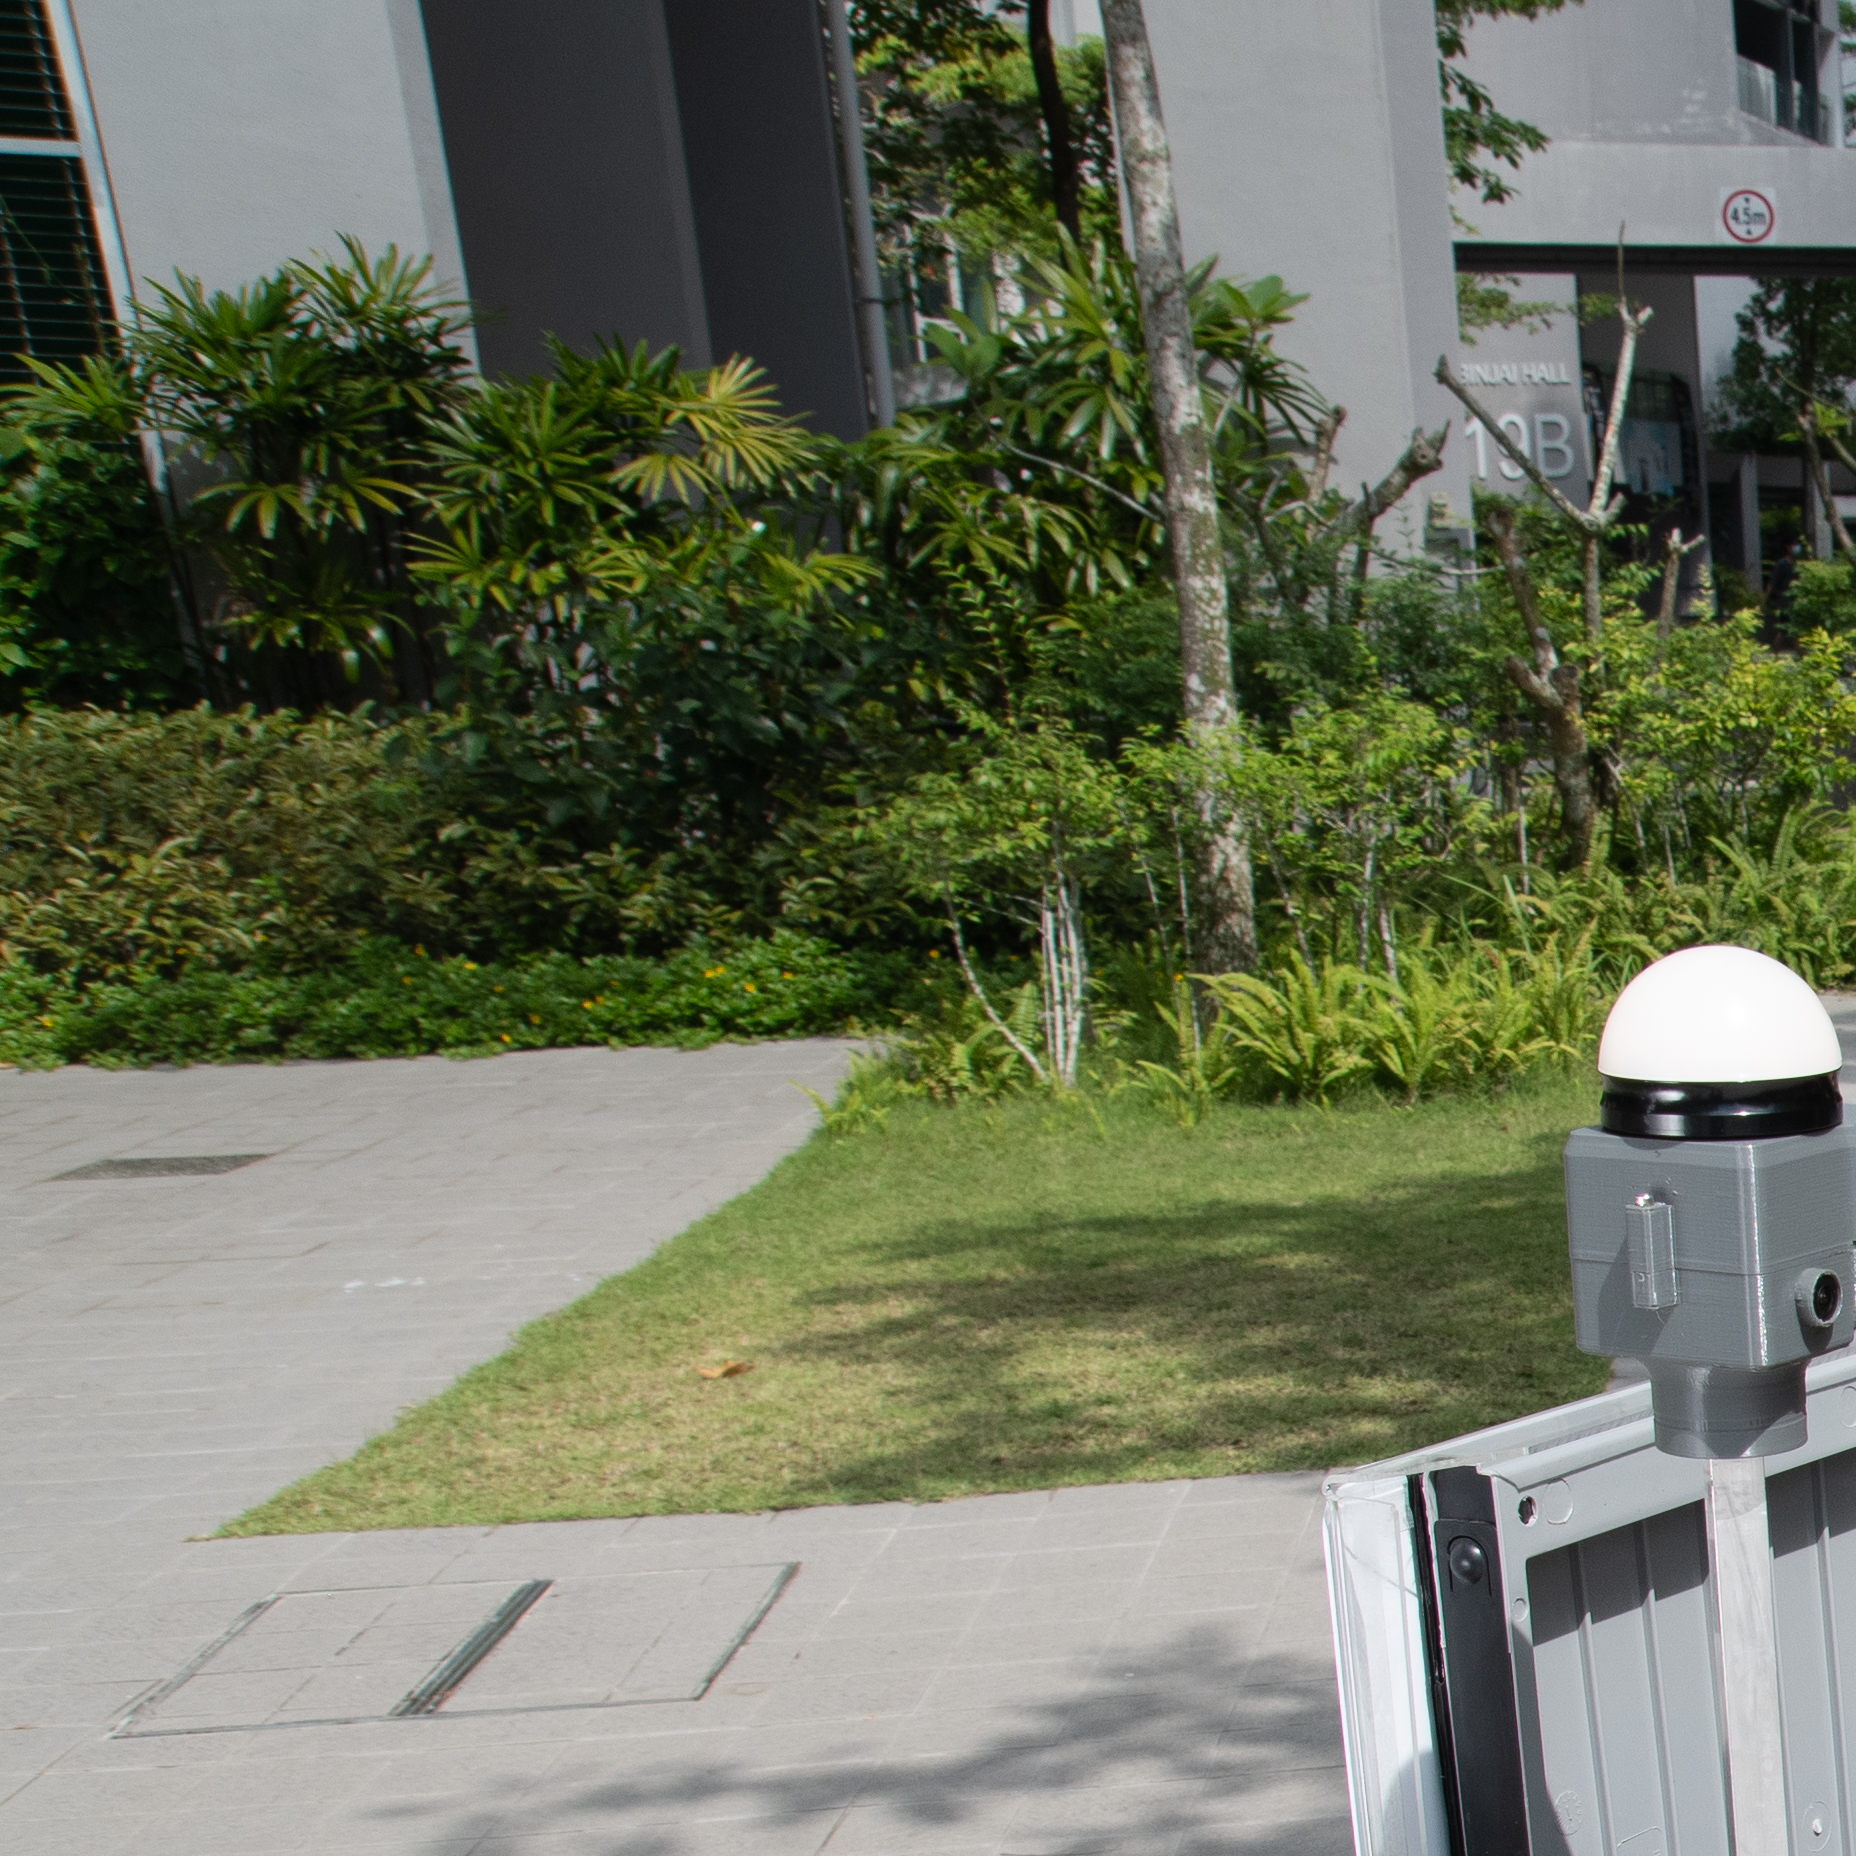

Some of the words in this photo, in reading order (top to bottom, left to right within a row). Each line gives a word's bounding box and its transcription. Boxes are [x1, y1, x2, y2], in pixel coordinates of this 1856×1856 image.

[1730, 207, 1767, 225] 4.5m
[1522, 362, 1571, 385] HALL
[1465, 412, 1575, 480] 19B
